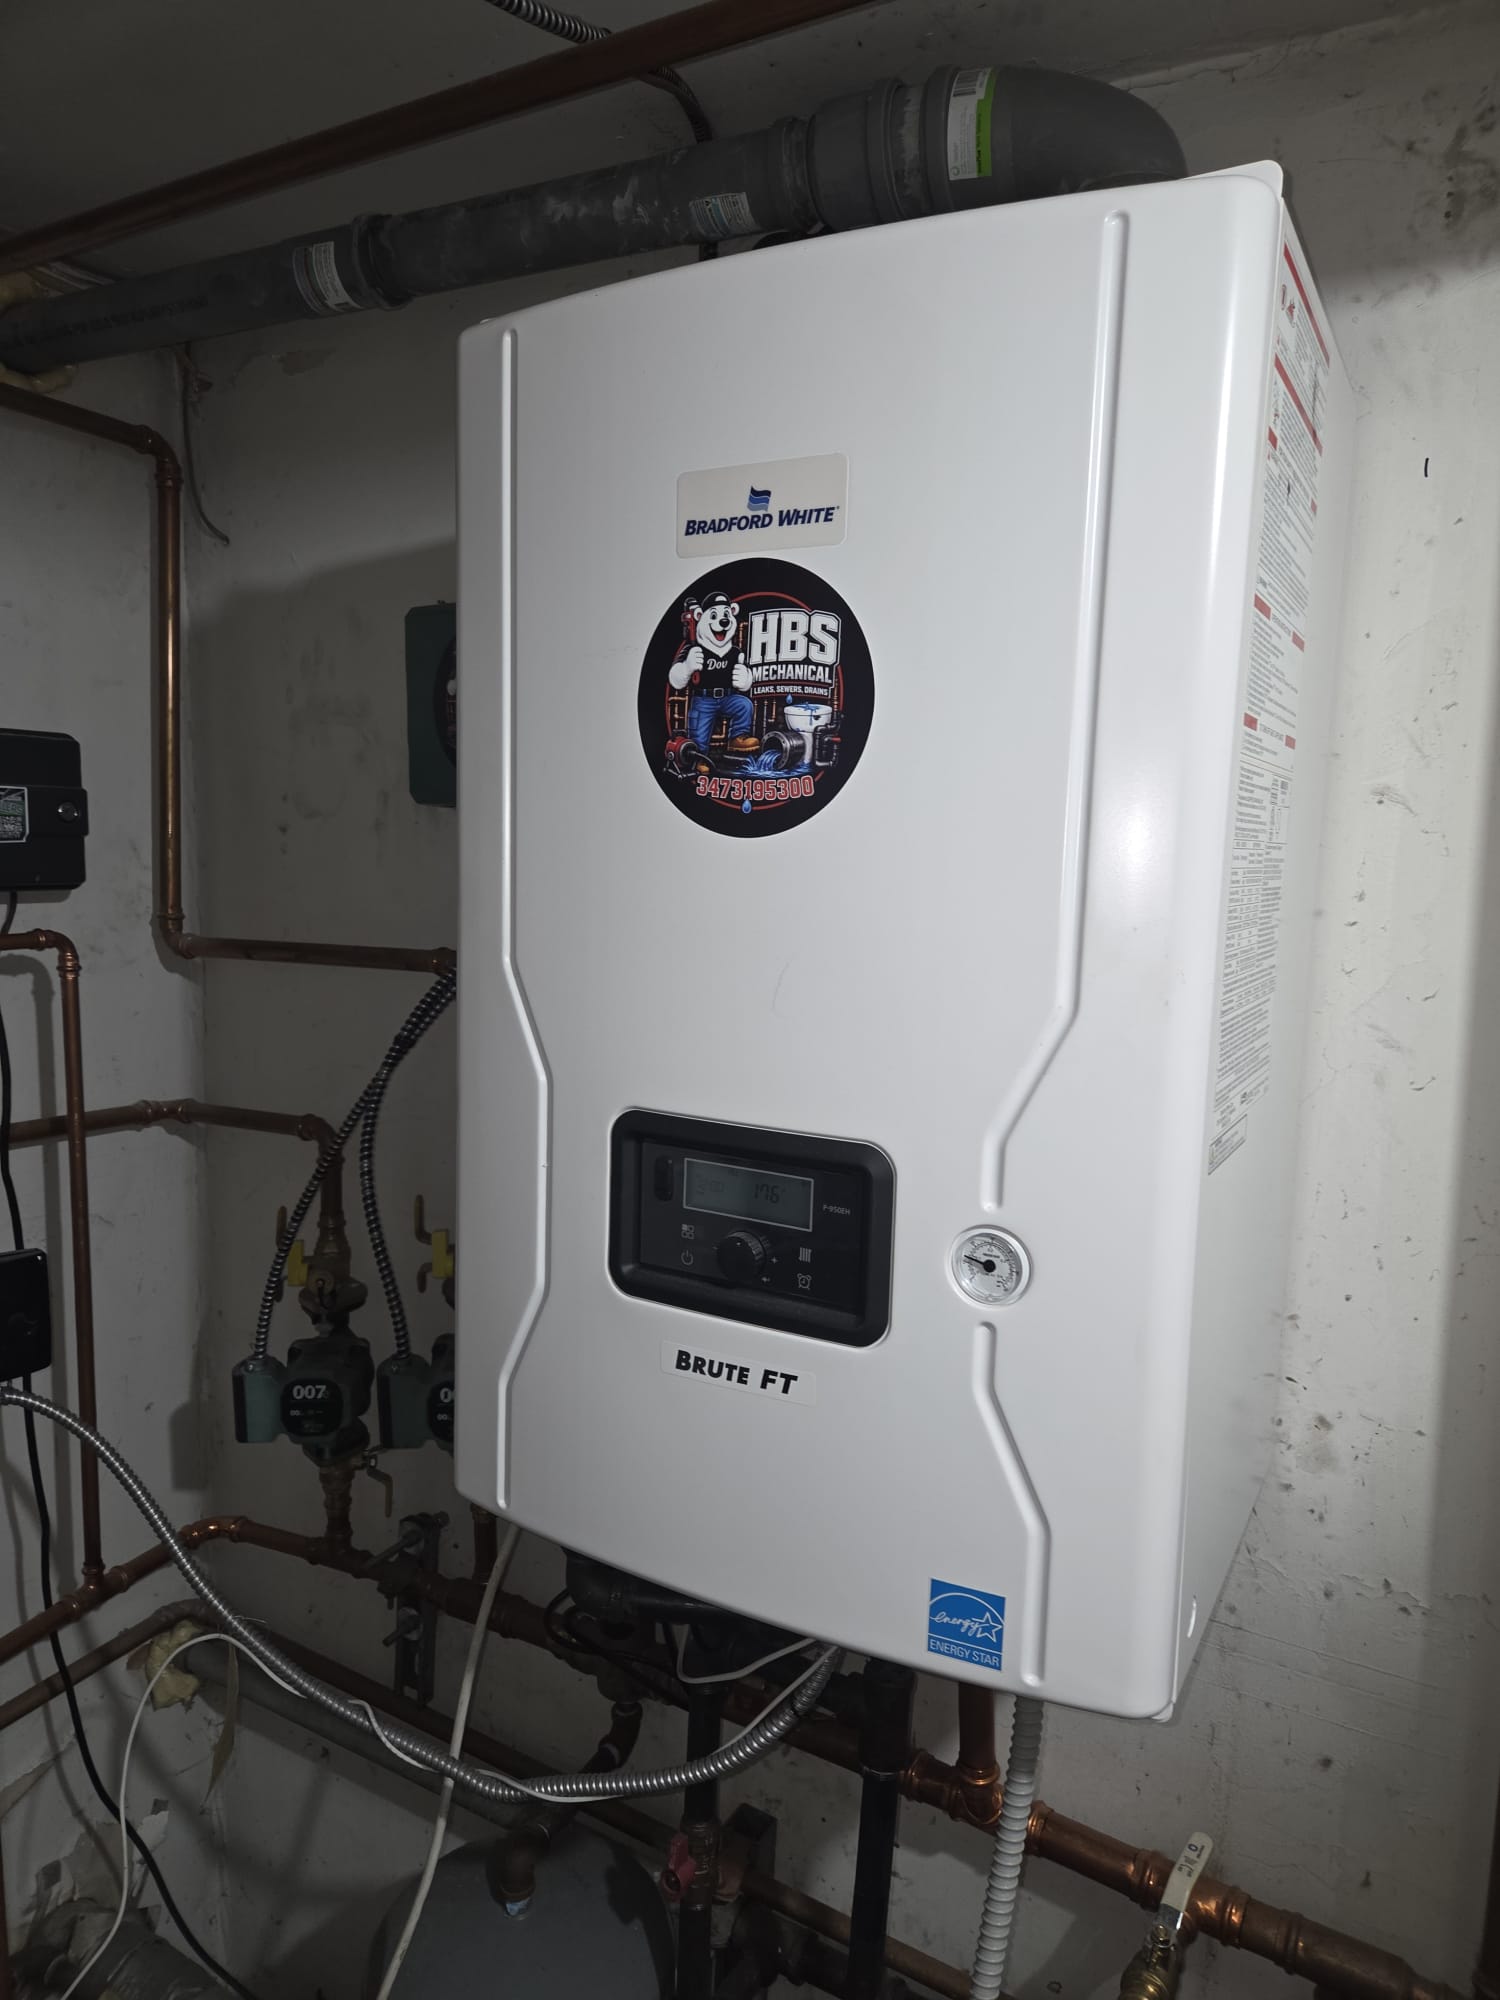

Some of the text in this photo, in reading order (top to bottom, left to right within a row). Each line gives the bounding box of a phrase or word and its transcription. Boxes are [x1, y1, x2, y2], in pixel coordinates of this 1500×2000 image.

[684, 506, 836, 536] BRADFORD WHITE
[749, 610, 839, 665] HBS
[706, 658, 728, 671] Dov
[752, 664, 832, 683] MECHANICAL
[753, 685, 829, 696] LEAKS, SEWERS, DRAINS
[695, 775, 815, 801] 3473195300
[675, 1349, 799, 1395] BRUTE FT
[929, 1610, 982, 1637] energy
[929, 1639, 1000, 1667] ENERGY STAR
